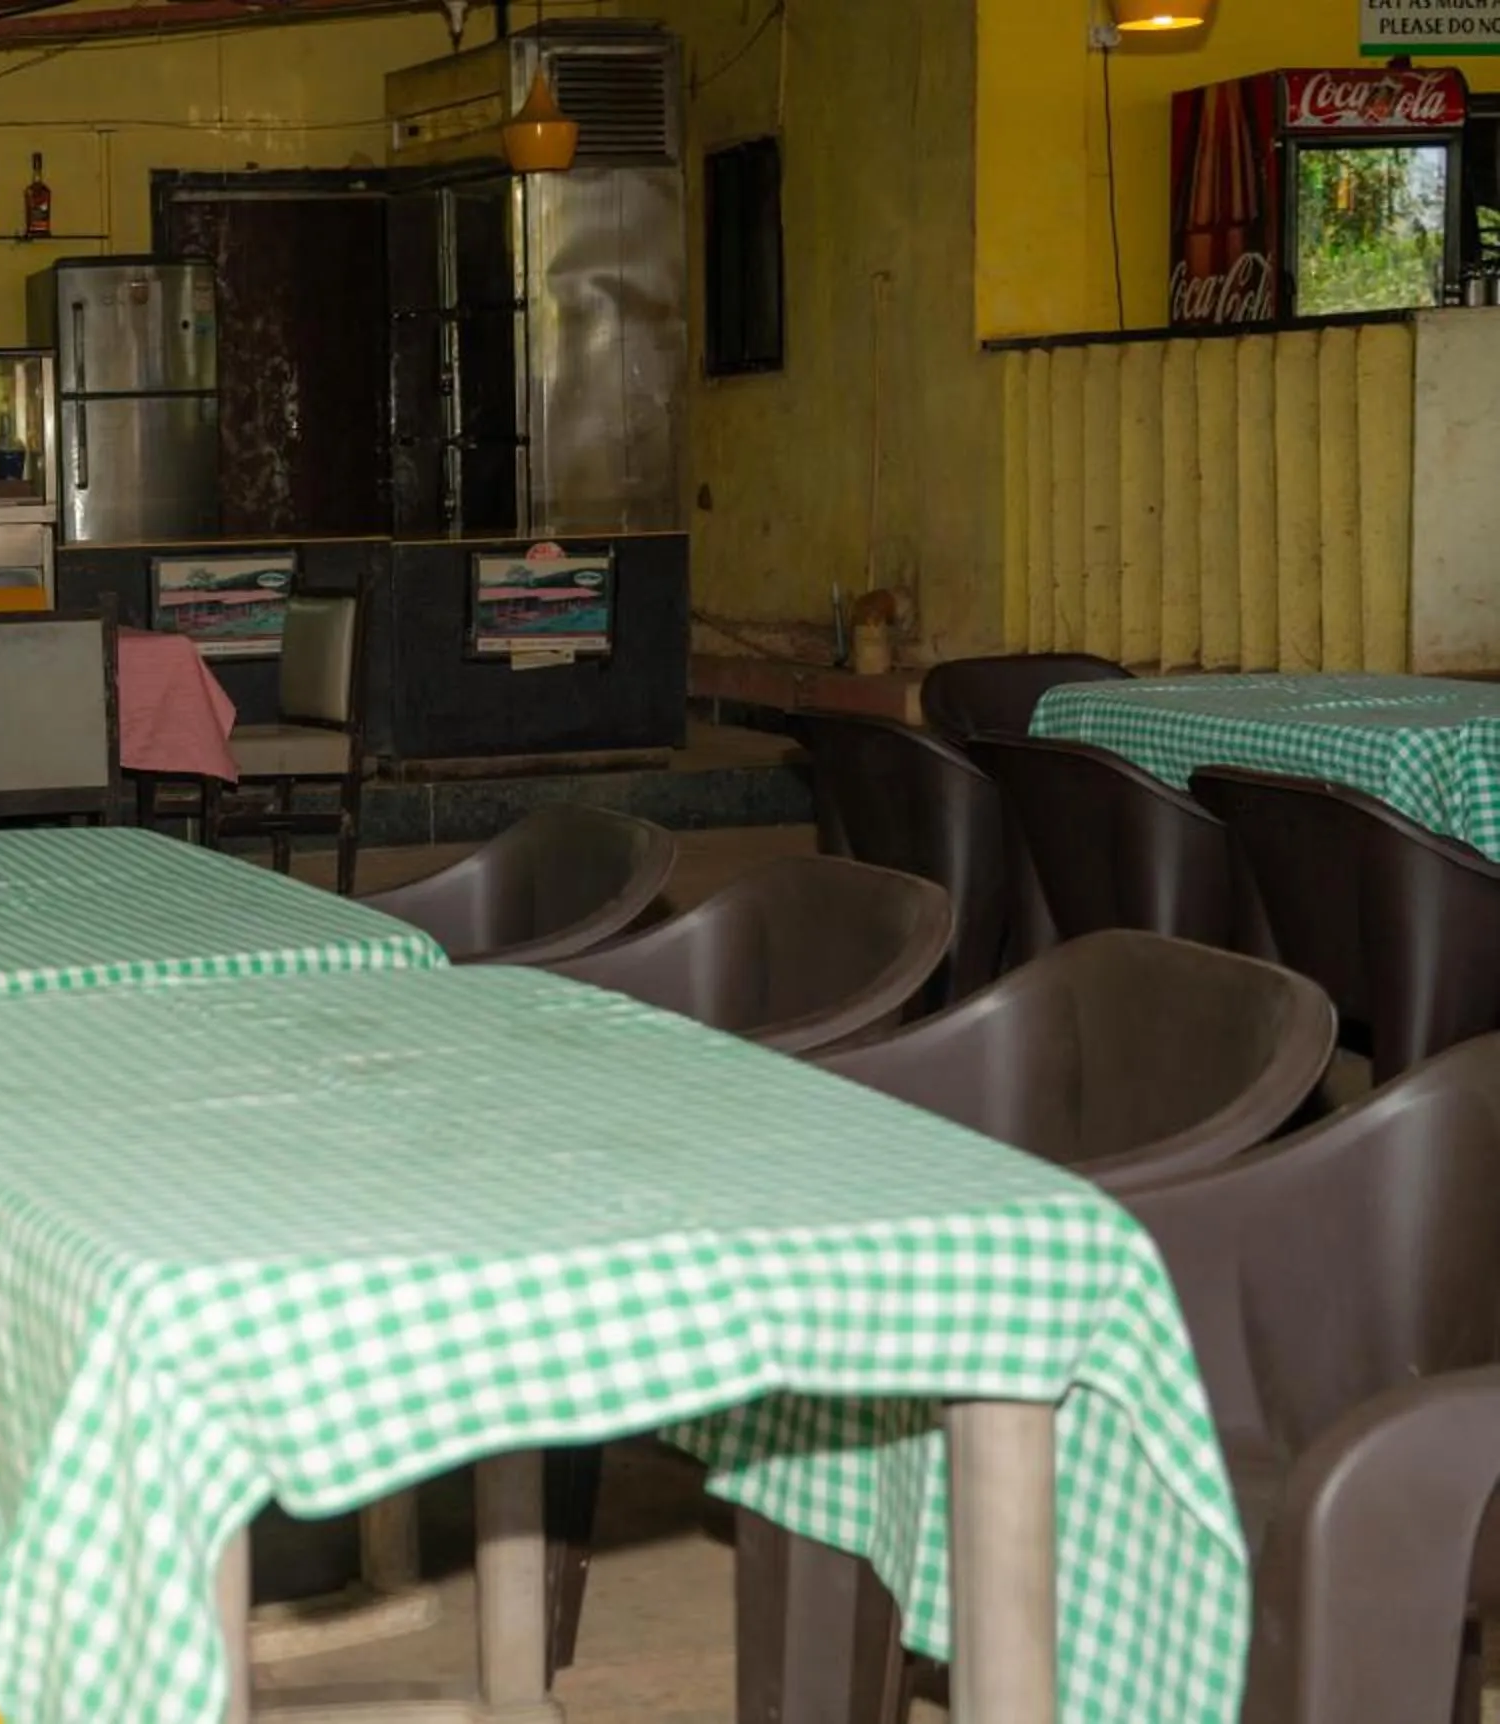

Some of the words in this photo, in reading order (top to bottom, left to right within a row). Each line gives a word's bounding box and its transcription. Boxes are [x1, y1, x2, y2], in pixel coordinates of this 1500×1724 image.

[1379, 17, 1443, 35] PLEASE
[1448, 17, 1475, 35] DO
[1300, 71, 1448, 120] Coca-ola
